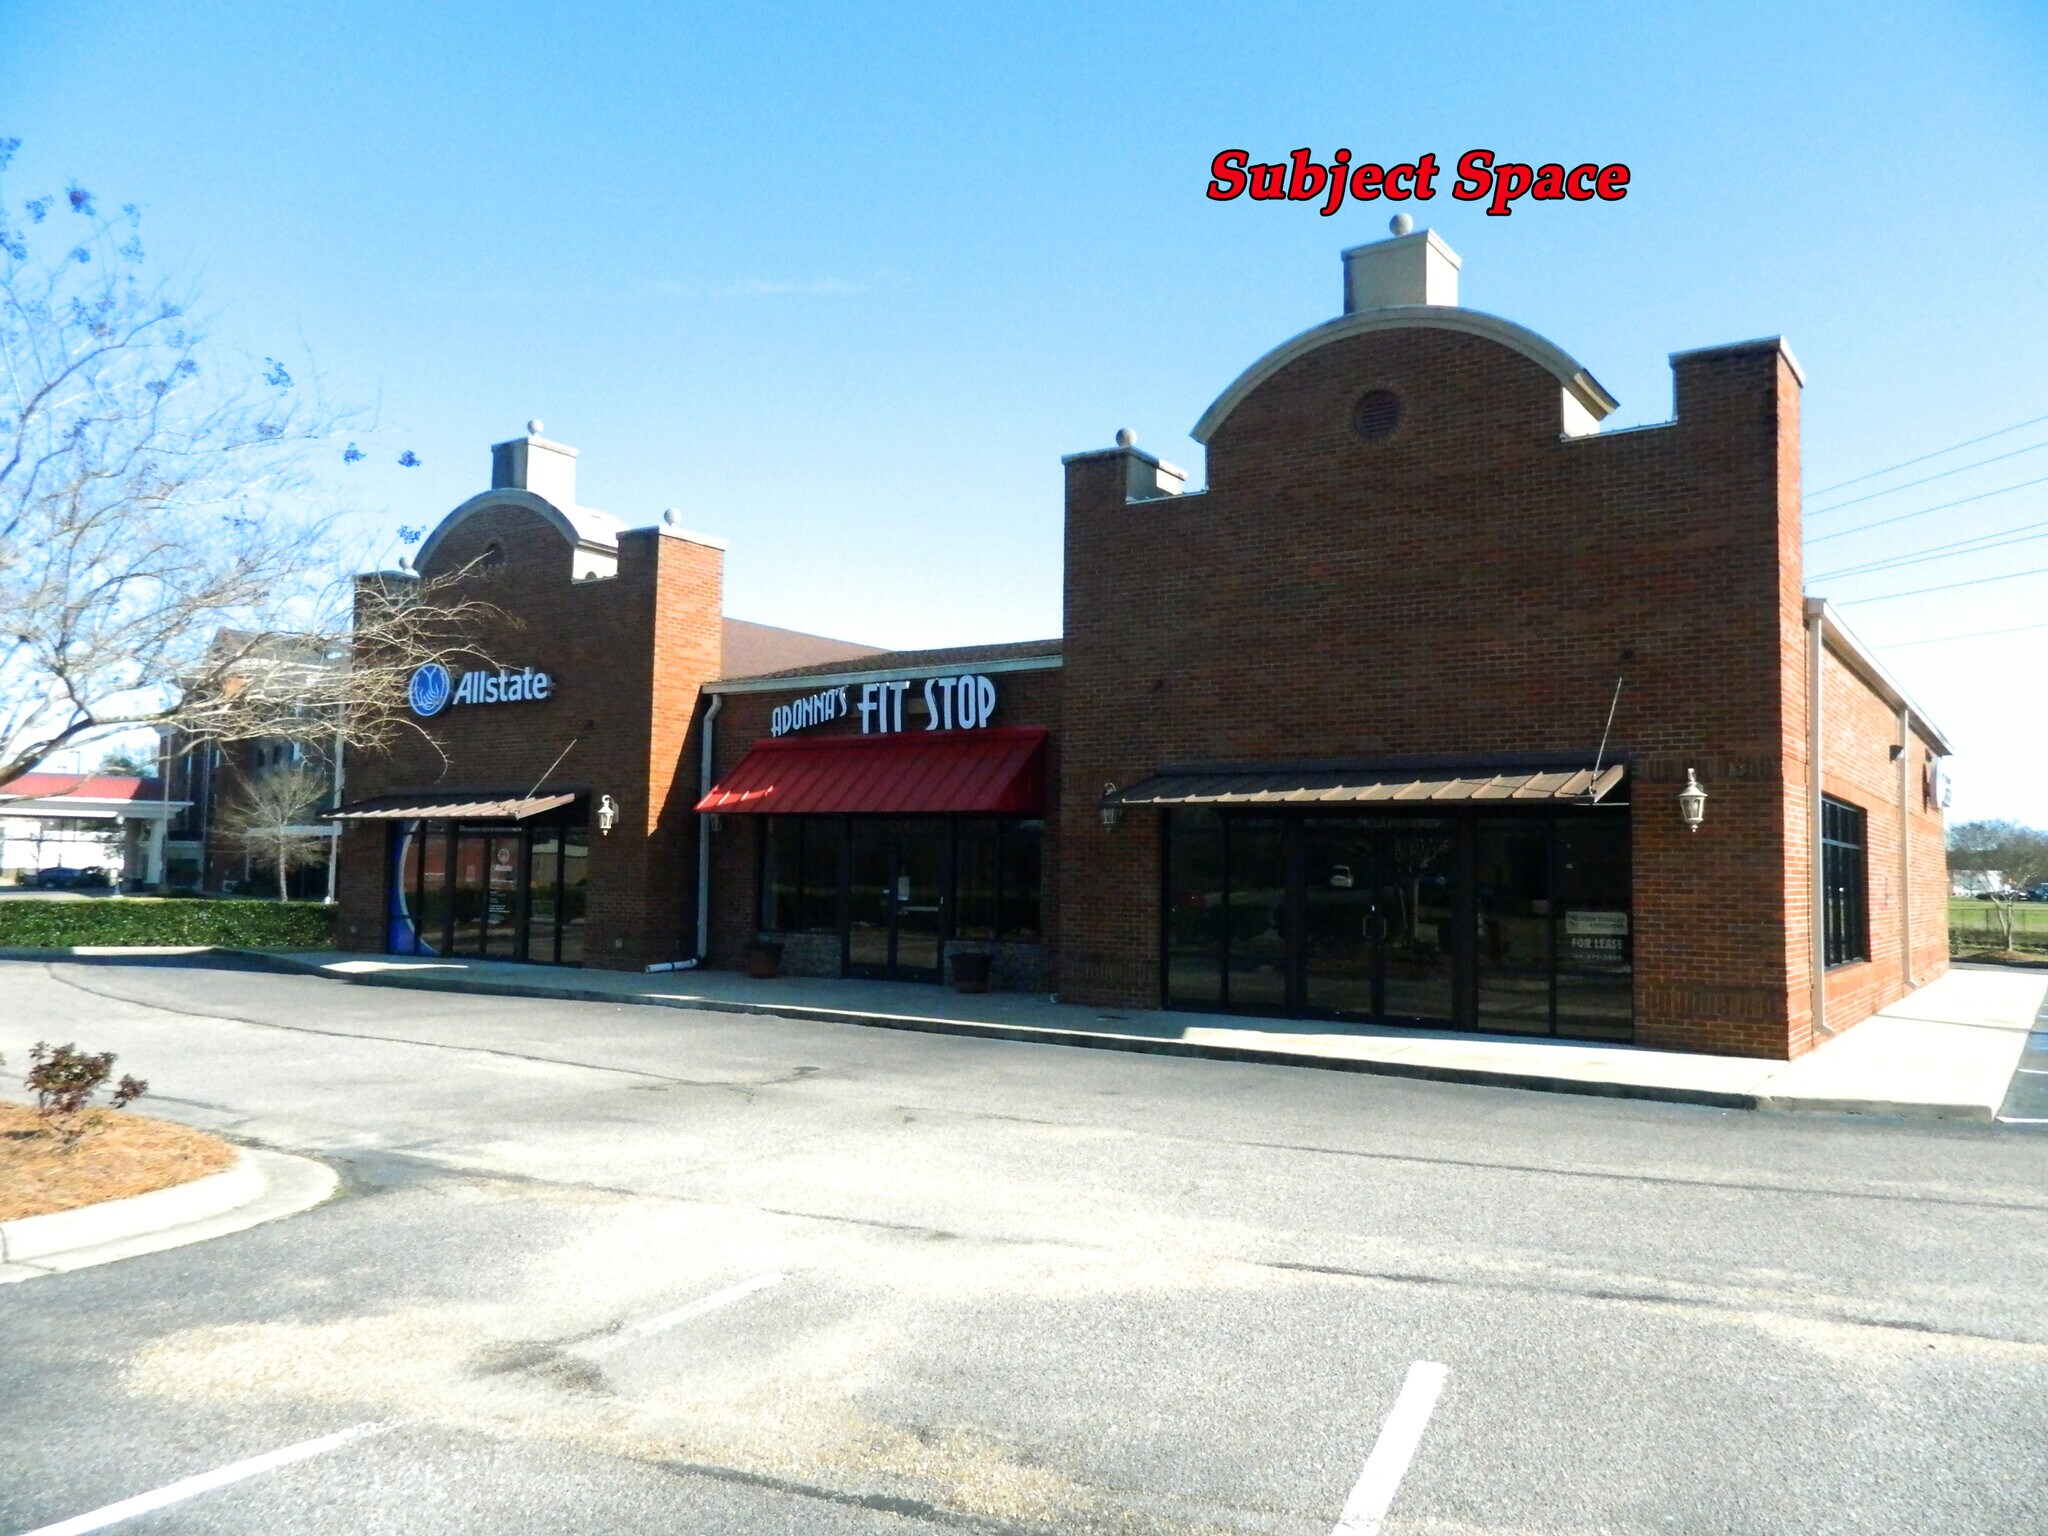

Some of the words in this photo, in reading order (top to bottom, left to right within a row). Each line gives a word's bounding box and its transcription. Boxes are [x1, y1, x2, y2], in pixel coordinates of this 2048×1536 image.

[452, 667, 550, 705] Allstate
[770, 684, 849, 738] ADONNA'S
[857, 681, 911, 734] FIT
[924, 674, 997, 731] STOP
[1571, 937, 1592, 949] FOR
[1594, 938, 1623, 950] LEASE
